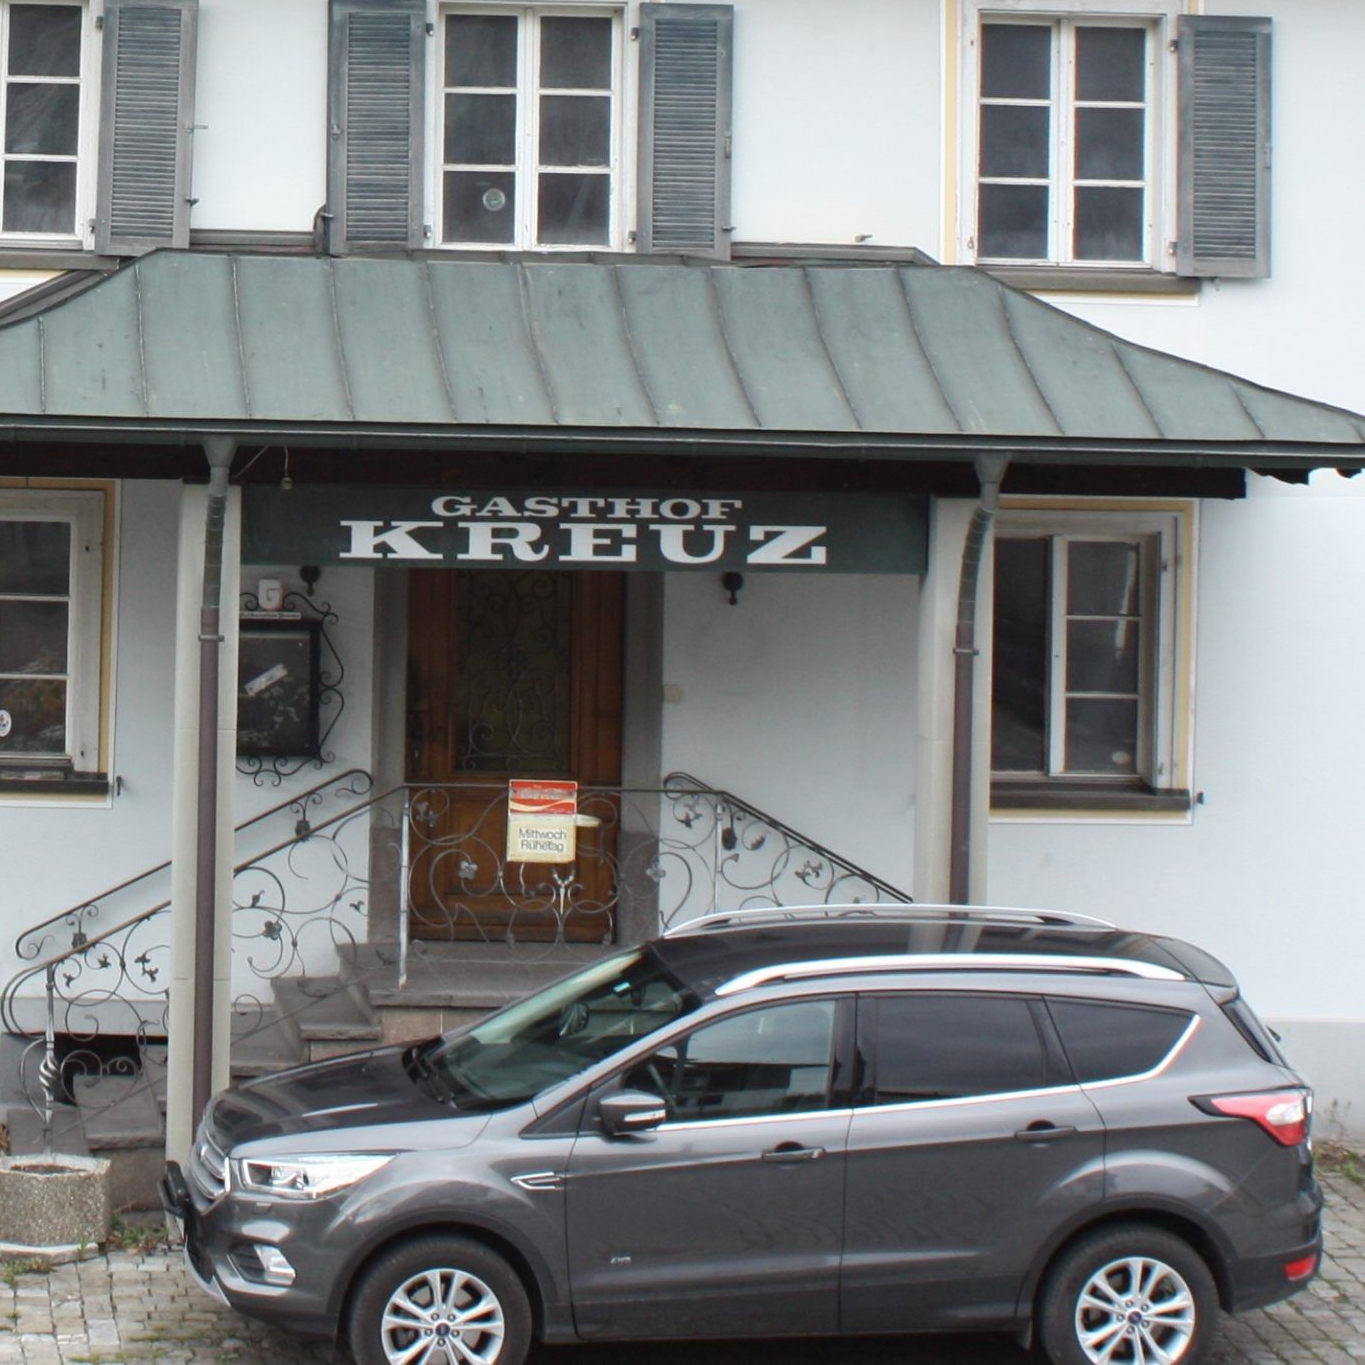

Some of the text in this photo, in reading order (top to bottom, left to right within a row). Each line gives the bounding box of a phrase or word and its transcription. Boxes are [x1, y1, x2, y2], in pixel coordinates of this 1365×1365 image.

[431, 496, 742, 519] GASTHOF
[339, 520, 827, 565] KREUZ
[519, 828, 566, 840] Mittwoch
